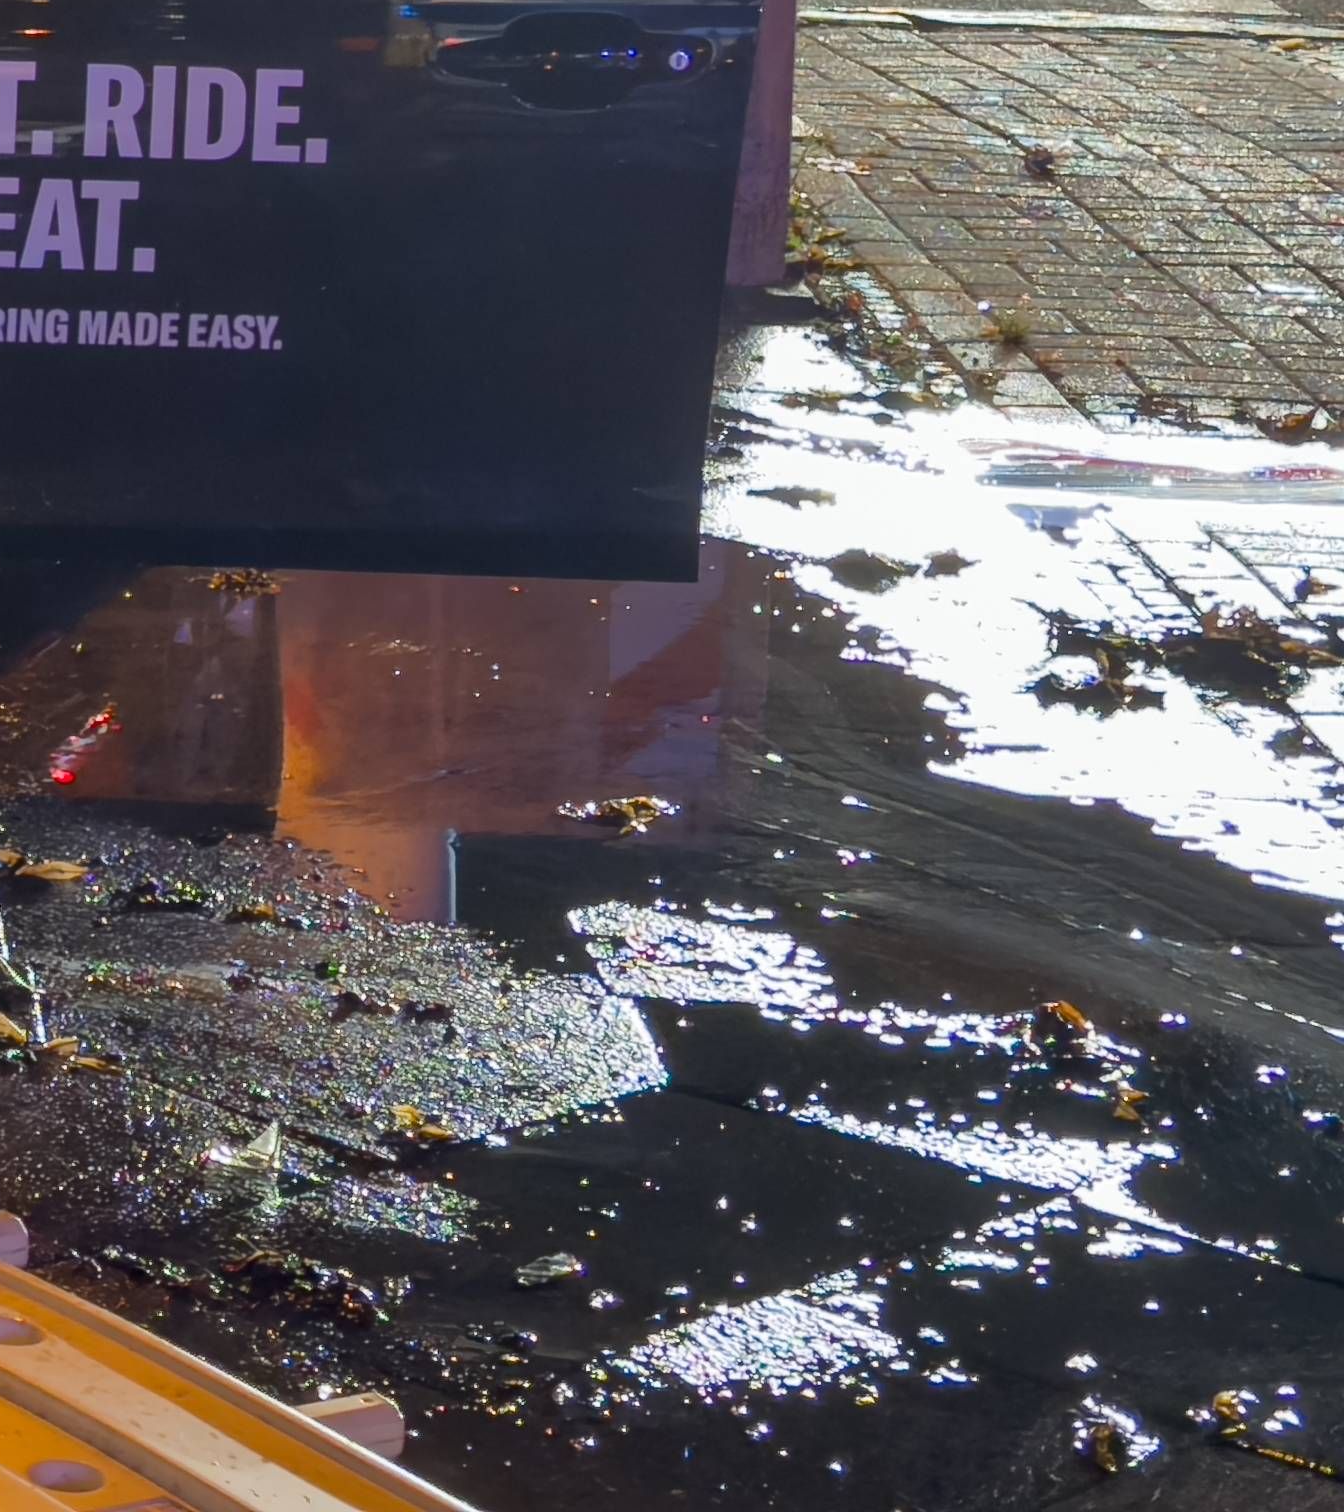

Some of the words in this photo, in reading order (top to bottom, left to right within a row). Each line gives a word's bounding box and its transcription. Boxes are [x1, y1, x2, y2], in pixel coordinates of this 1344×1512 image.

[83, 63, 328, 164] RIDE.
[78, 310, 180, 348] MADE
[187, 313, 283, 350] EASY.
